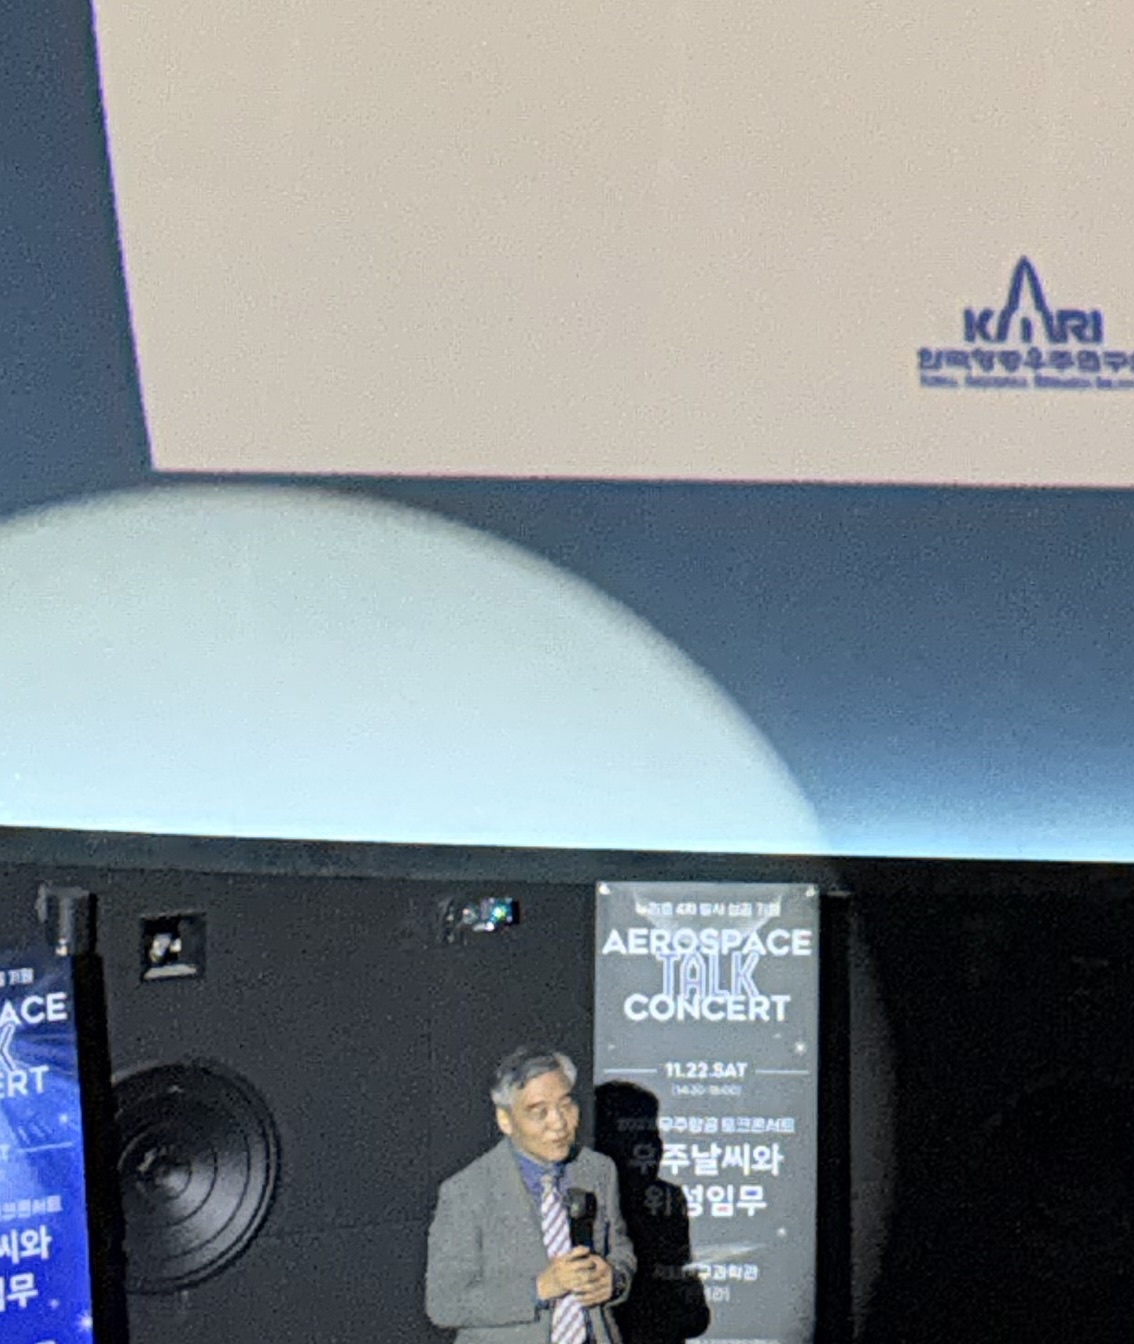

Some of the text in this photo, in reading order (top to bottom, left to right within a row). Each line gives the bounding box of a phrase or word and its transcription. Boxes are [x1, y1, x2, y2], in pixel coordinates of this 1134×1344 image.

[964, 256, 1103, 343] KARI
[602, 928, 812, 956] AEROSPACE
[656, 951, 760, 999] TALK
[0, 992, 68, 1026] ACE
[623, 994, 791, 1022] CONCERT
[0, 1065, 49, 1097] RT
[0, 1272, 38, 1312] 무
